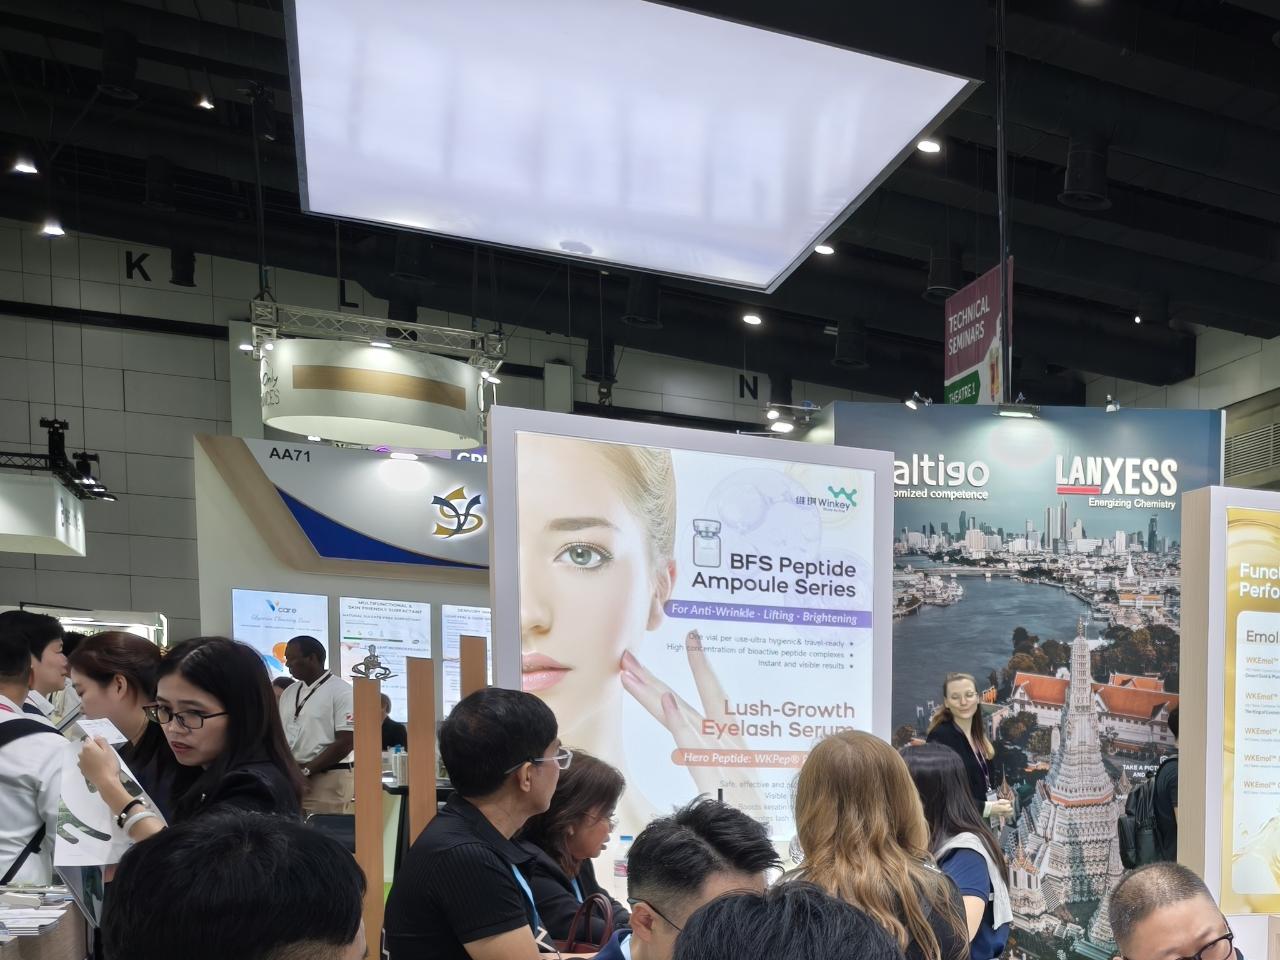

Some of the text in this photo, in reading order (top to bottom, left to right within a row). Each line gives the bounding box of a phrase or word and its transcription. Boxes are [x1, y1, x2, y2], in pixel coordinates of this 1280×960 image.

[125, 250, 151, 282] K
[949, 295, 990, 334] TECHNICAL
[948, 320, 985, 356] SEMINARS
[739, 374, 758, 400] N
[269, 446, 312, 463] AA71
[1055, 454, 1179, 497] LANXESS
[930, 488, 988, 501] competence
[1088, 497, 1176, 511] Energizing Chemistry
[818, 498, 851, 511] Winkey
[730, 552, 857, 579] BFS Peptide
[691, 571, 857, 598] Ampoule Series
[671, 603, 858, 625] For Anti-Wrinkle Lifting Brightening
[706, 634, 718, 642] vial
[720, 635, 732, 643] per
[666, 643, 684, 653] High
[738, 647, 746, 655] of
[747, 648, 779, 656] bioactive
[781, 649, 807, 658] peptide
[809, 650, 845, 659] complexes
[758, 660, 845, 670] Instant and visible results
[724, 700, 855, 719] Lush-Growth
[701, 719, 782, 739] Eyelash
[684, 753, 751, 765] Hero Peptide:
